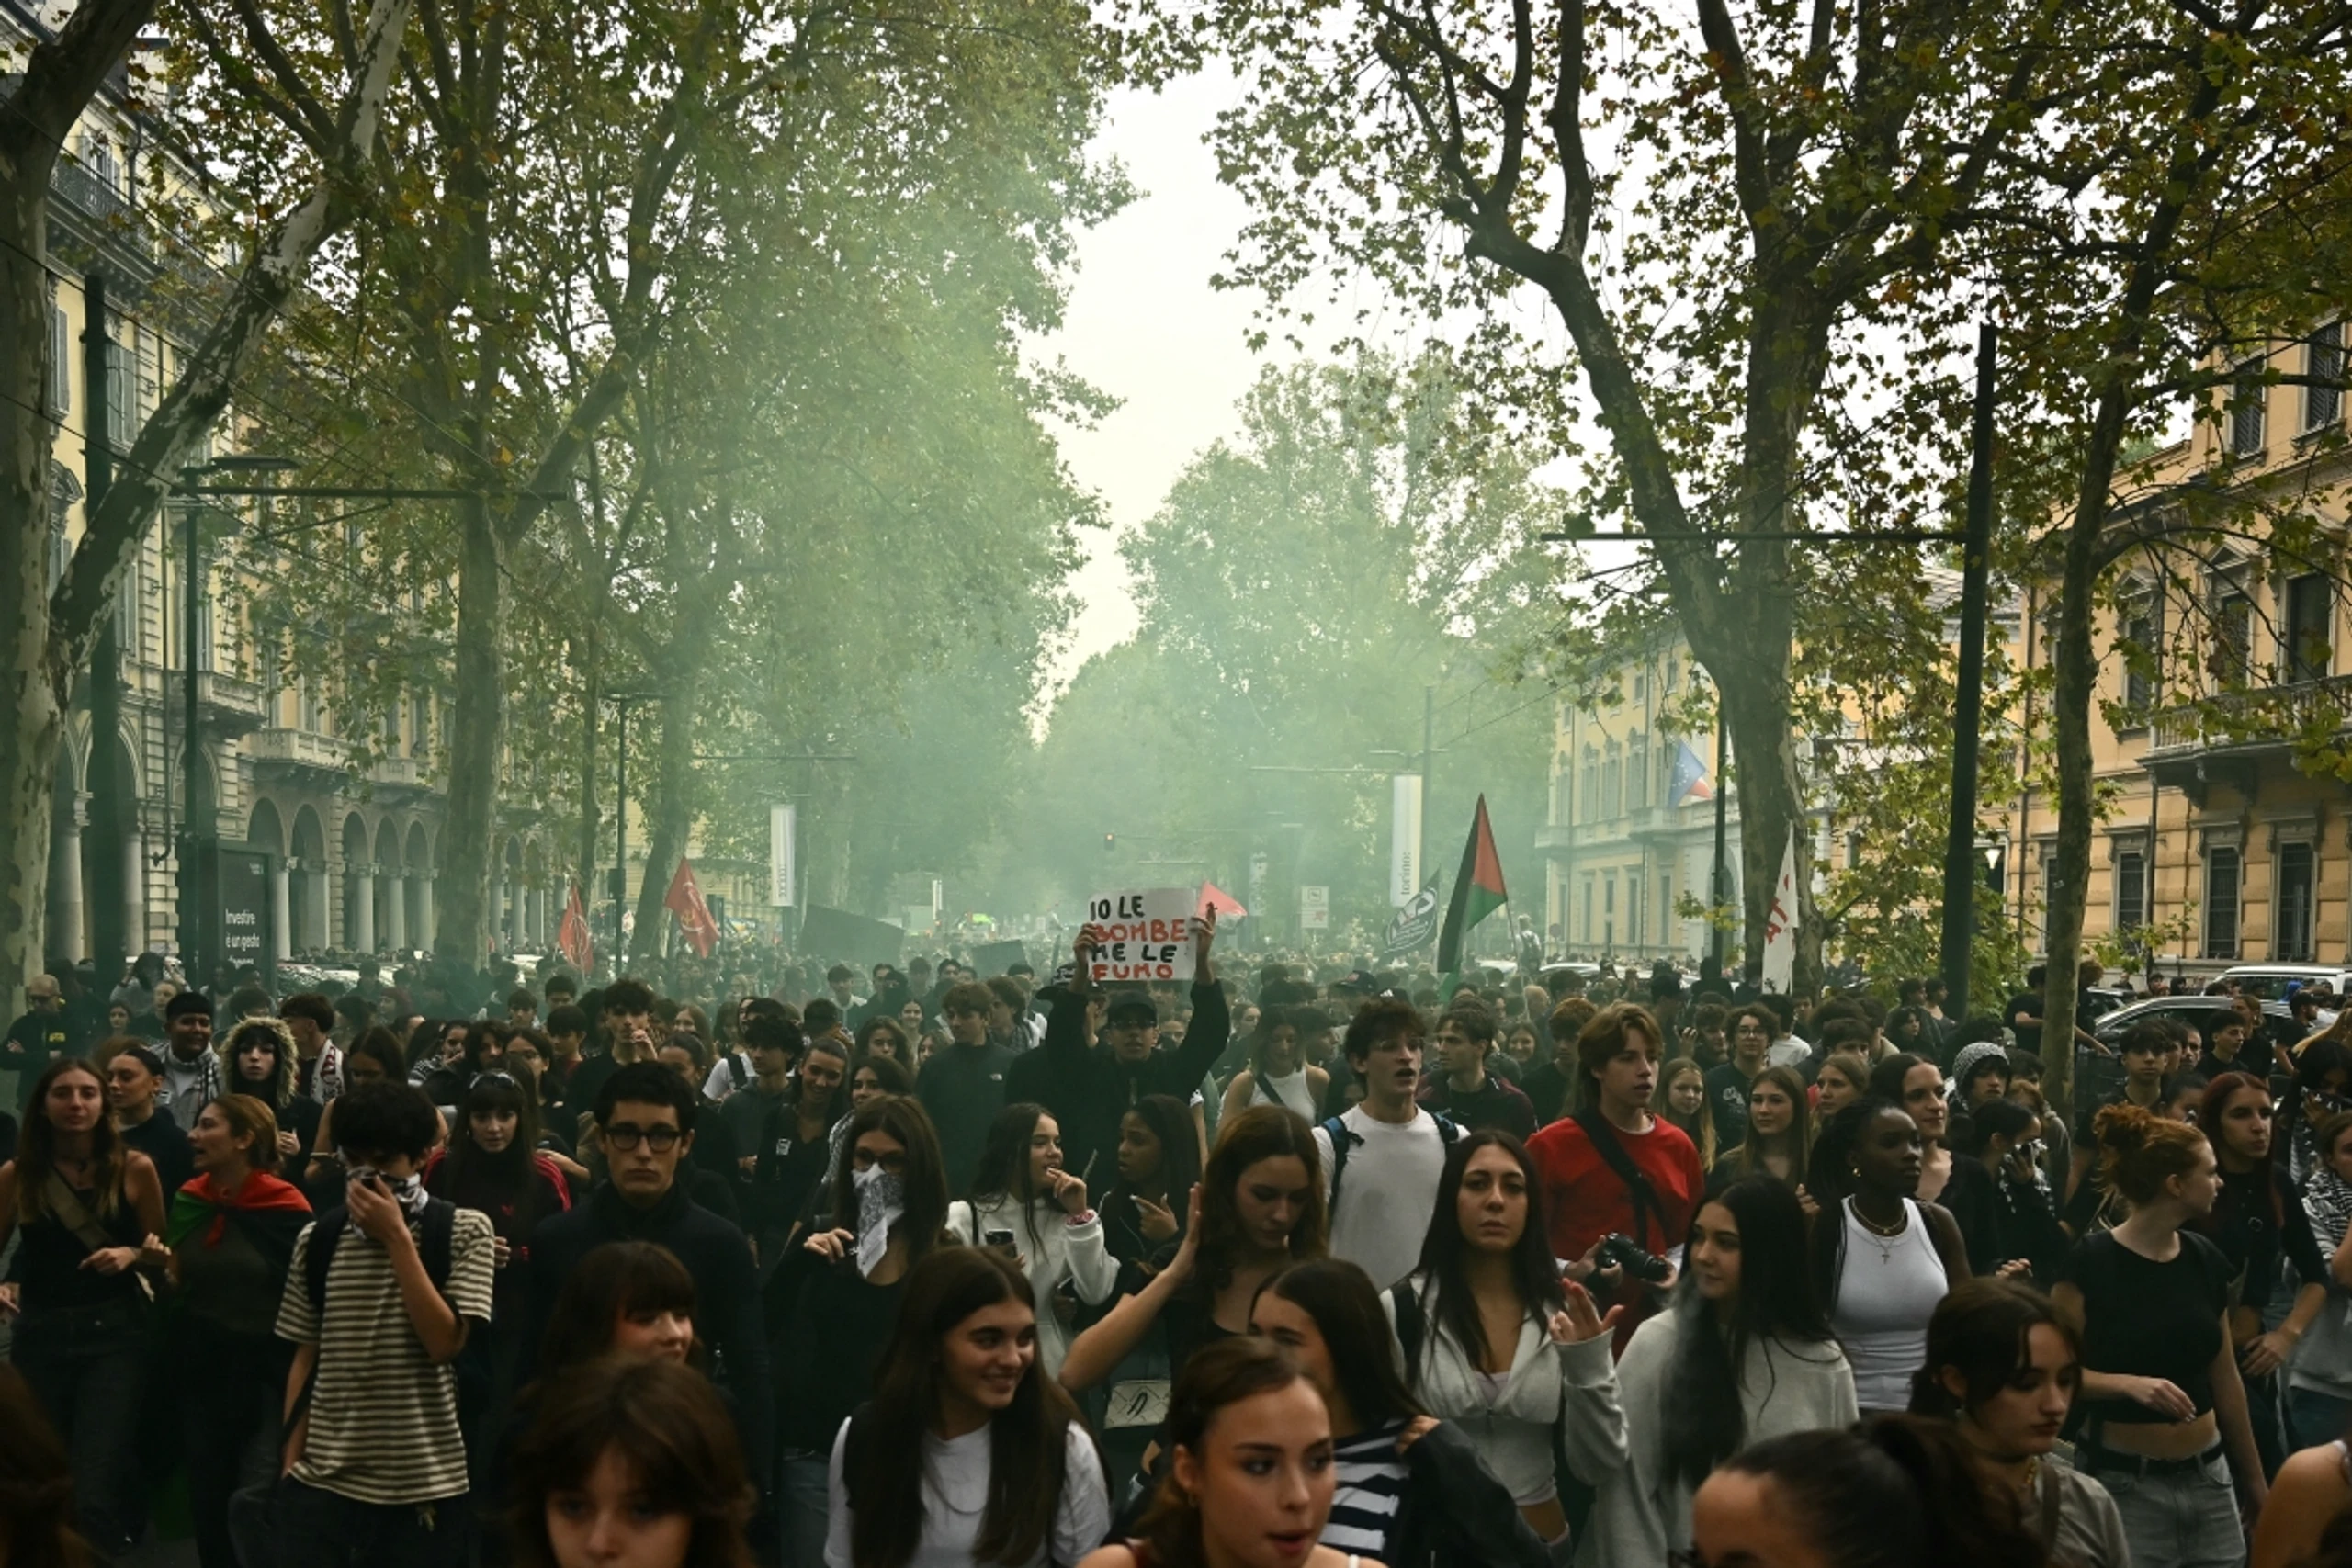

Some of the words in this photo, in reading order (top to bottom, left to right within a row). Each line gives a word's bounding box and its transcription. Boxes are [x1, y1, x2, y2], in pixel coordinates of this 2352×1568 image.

[225, 908, 256, 925] Investire
[1090, 899, 1111, 921] IO
[1118, 896, 1145, 919] LE
[1094, 919, 1189, 942] BOMBE
[1091, 942, 1126, 963] ME
[1141, 944, 1177, 963] LE
[1091, 963, 1173, 982] FUMO
